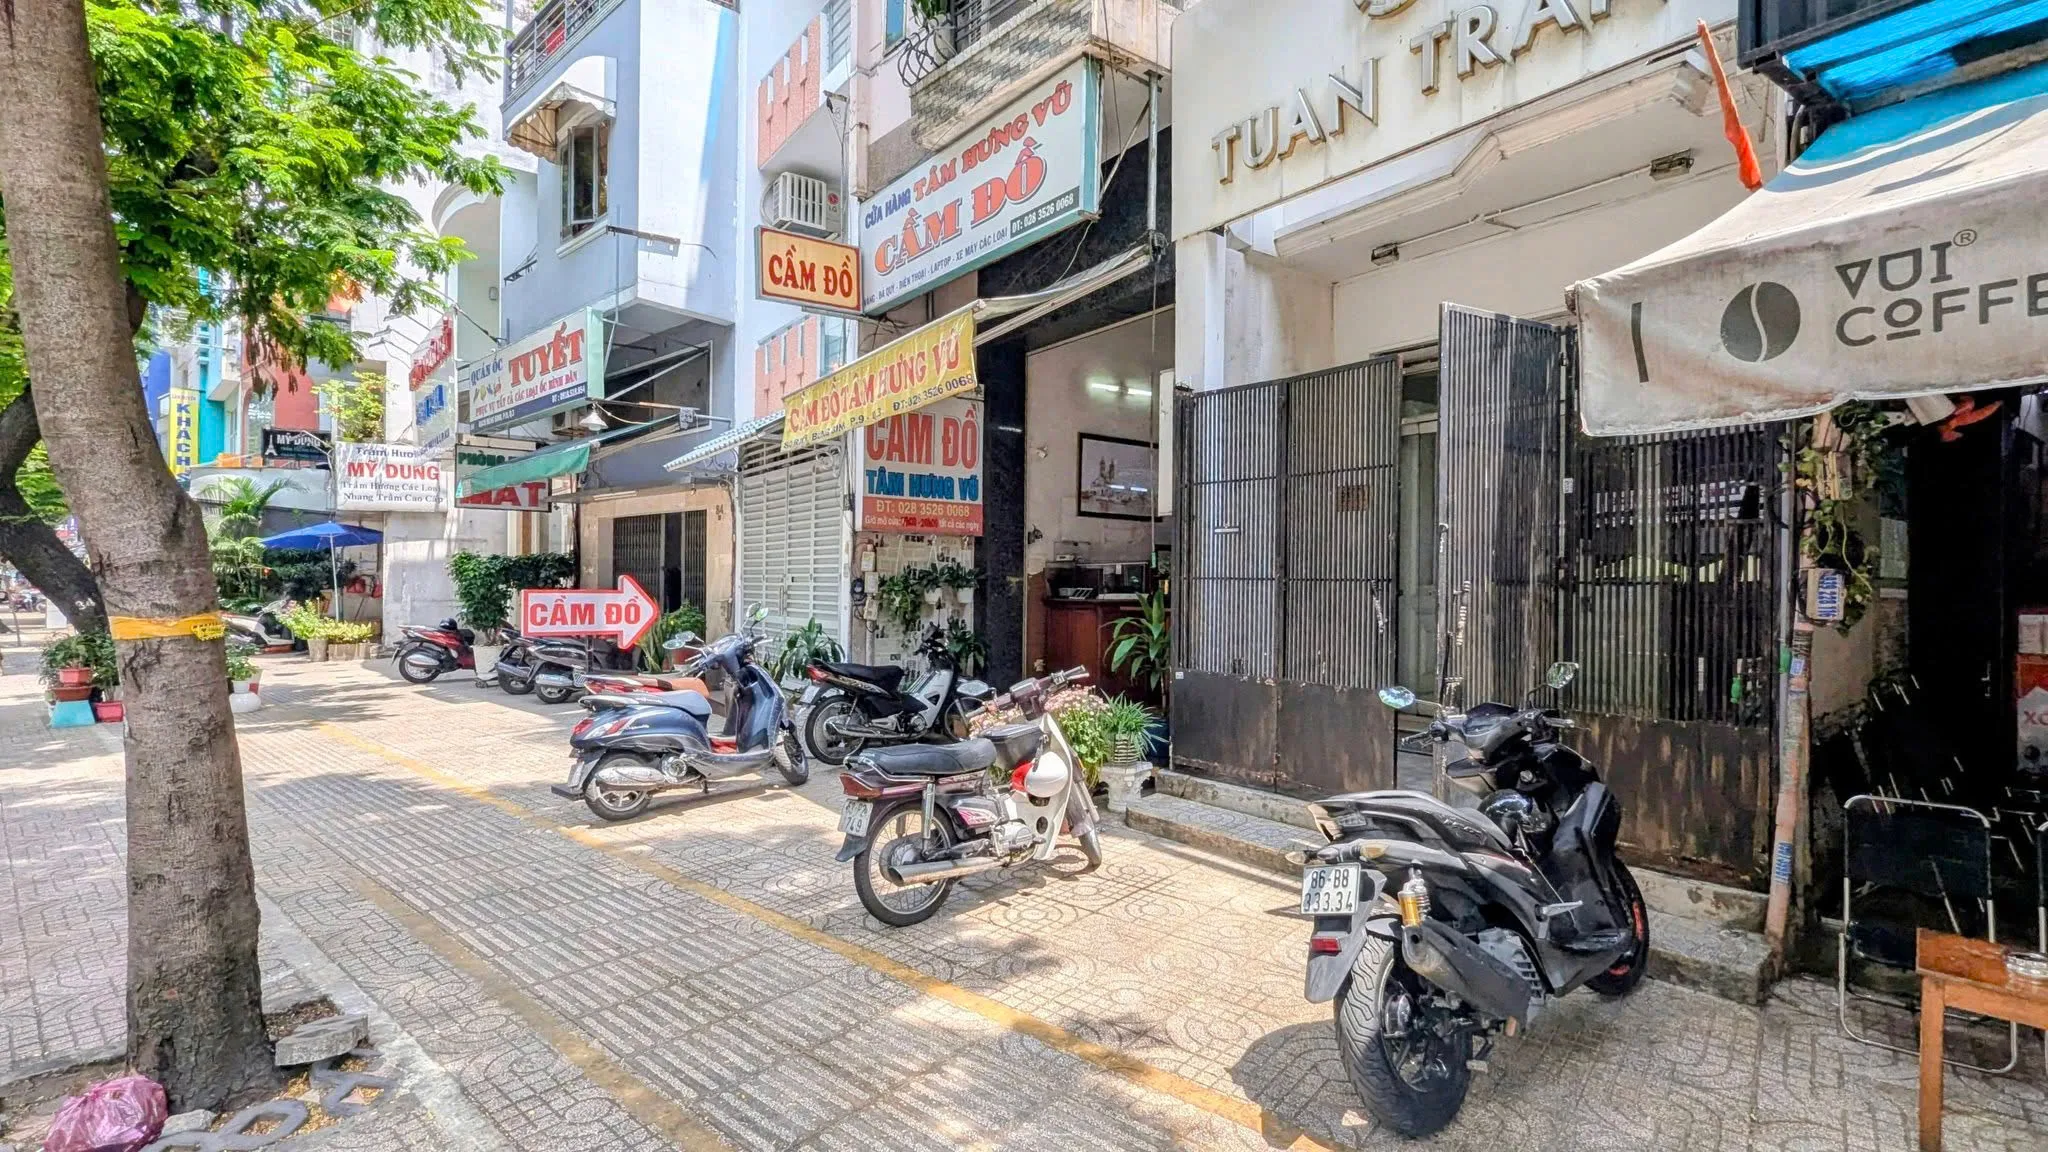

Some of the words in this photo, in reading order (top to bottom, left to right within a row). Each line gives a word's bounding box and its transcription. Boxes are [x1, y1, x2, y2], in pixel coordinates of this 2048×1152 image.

[1408, 0, 1616, 97] TRA
[885, 188, 911, 218] HÀNG
[913, 157, 957, 202] TÂM
[962, 113, 1029, 173] HƯNG
[875, 207, 963, 276] CẦM
[970, 136, 1048, 226] ĐỒ
[1023, 211, 1037, 227] 028
[1038, 202, 1055, 220] 3526
[1056, 193, 1074, 211] 0068
[768, 244, 817, 292] CẦM
[823, 255, 853, 298] ĐỒ
[930, 255, 952, 275] LAPTOP
[955, 250, 964, 262] XE
[509, 321, 585, 388] TUYẾT
[945, 373, 975, 391] 0068
[942, 403, 978, 470] ĐỒ
[347, 459, 378, 478] MỸ
[385, 464, 440, 480] DUNG
[866, 466, 905, 497] TÂM
[909, 473, 955, 500] HƯNG
[343, 492, 374, 502] Nhang
[405, 493, 423, 503] Cao
[402, 483, 419, 492] Các
[876, 500, 895, 513] ĐT:
[898, 501, 917, 514] 028
[920, 503, 945, 517] 3526
[947, 505, 970, 518] 0068
[530, 595, 595, 626] CẦM
[605, 595, 641, 625] ĐỒ
[1311, 868, 1350, 889] 86-B8
[1303, 890, 1353, 912] 333.34
